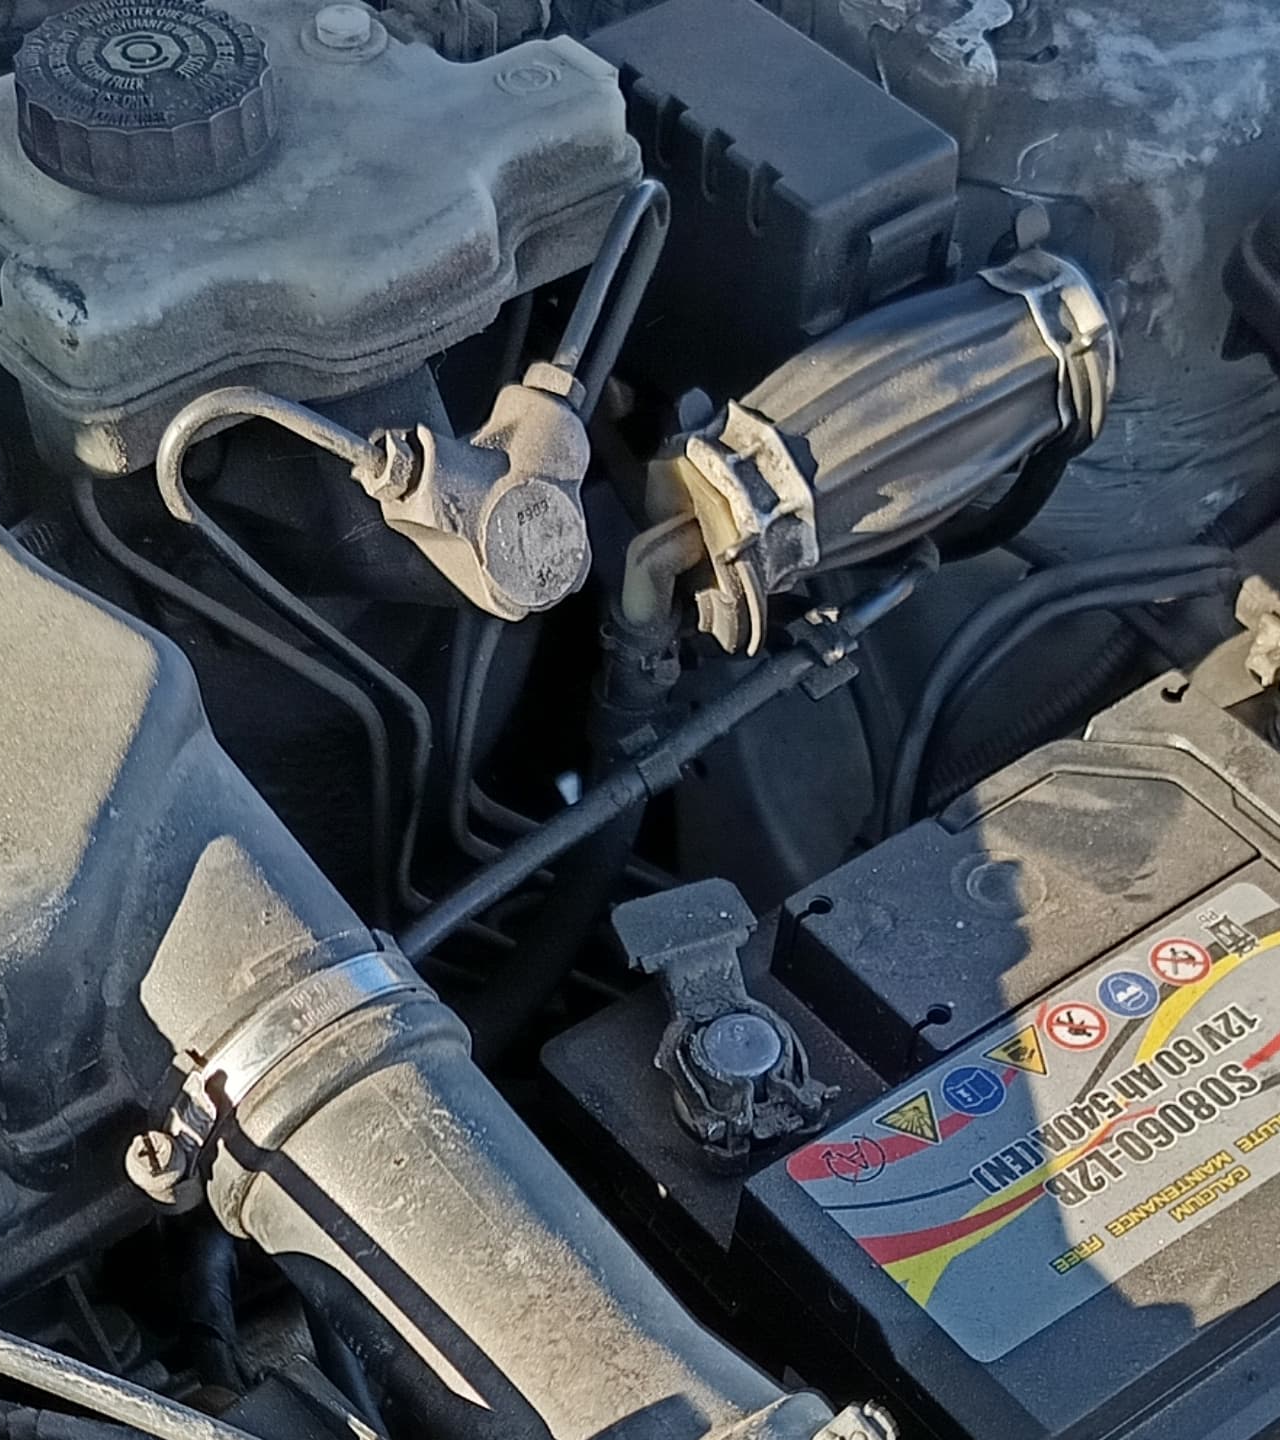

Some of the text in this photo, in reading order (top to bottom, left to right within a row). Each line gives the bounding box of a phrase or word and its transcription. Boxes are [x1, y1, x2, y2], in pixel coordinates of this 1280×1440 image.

[1196, 1004, 1260, 1052] 12V
[1154, 1037, 1206, 1078] 60
[1112, 1063, 1164, 1104] Ah
[1108, 1149, 1233, 1238] MAINTENANCE
[1168, 1165, 1250, 1222] CALCIUM
[1049, 1233, 1104, 1275] FREE
